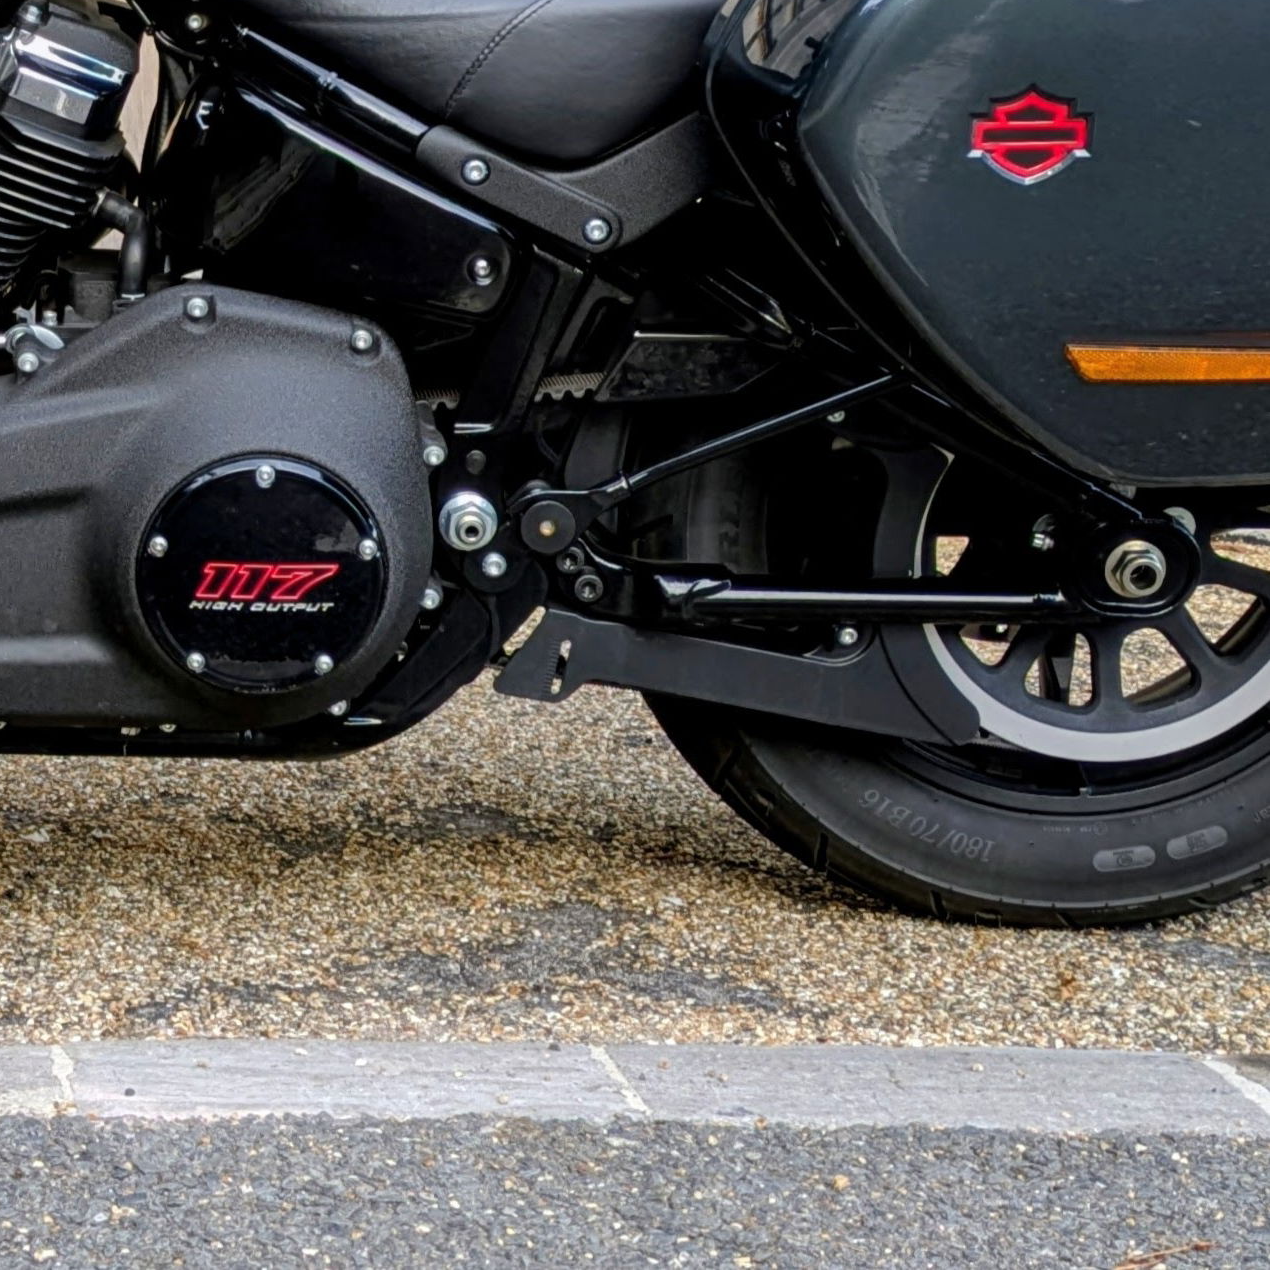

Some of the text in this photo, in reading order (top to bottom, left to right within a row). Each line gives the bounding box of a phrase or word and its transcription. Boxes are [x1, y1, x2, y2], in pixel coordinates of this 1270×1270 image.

[194, 562, 339, 600] 117
[189, 600, 334, 612] HIGH OUTPUT
